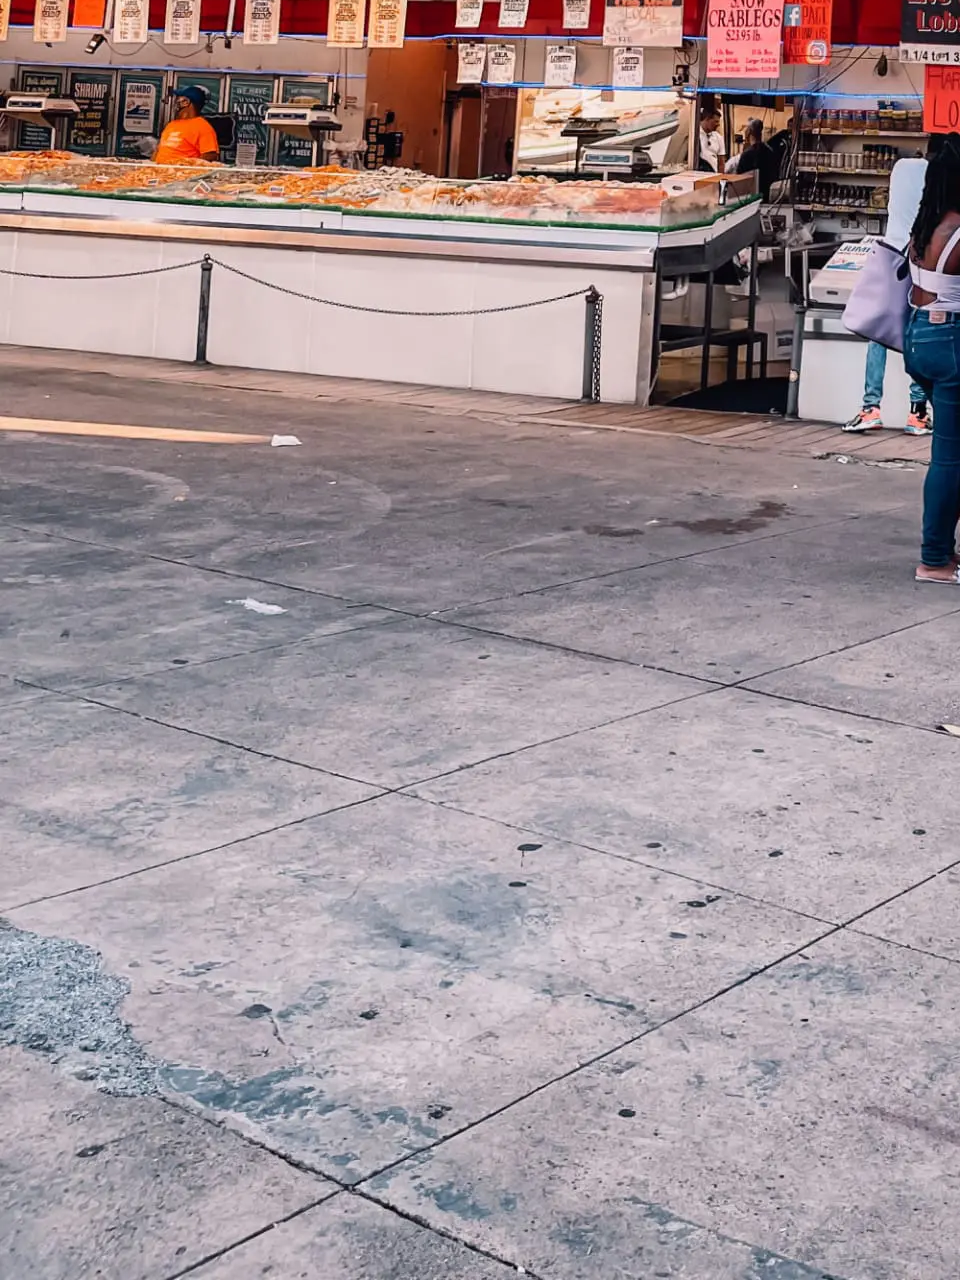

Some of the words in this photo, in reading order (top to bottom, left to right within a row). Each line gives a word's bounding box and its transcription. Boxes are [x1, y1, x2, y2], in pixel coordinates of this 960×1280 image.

[708, 9, 782, 28] CRABLEGS
[74, 82, 108, 99] SHRIMP
[127, 84, 152, 94] JUMBO
